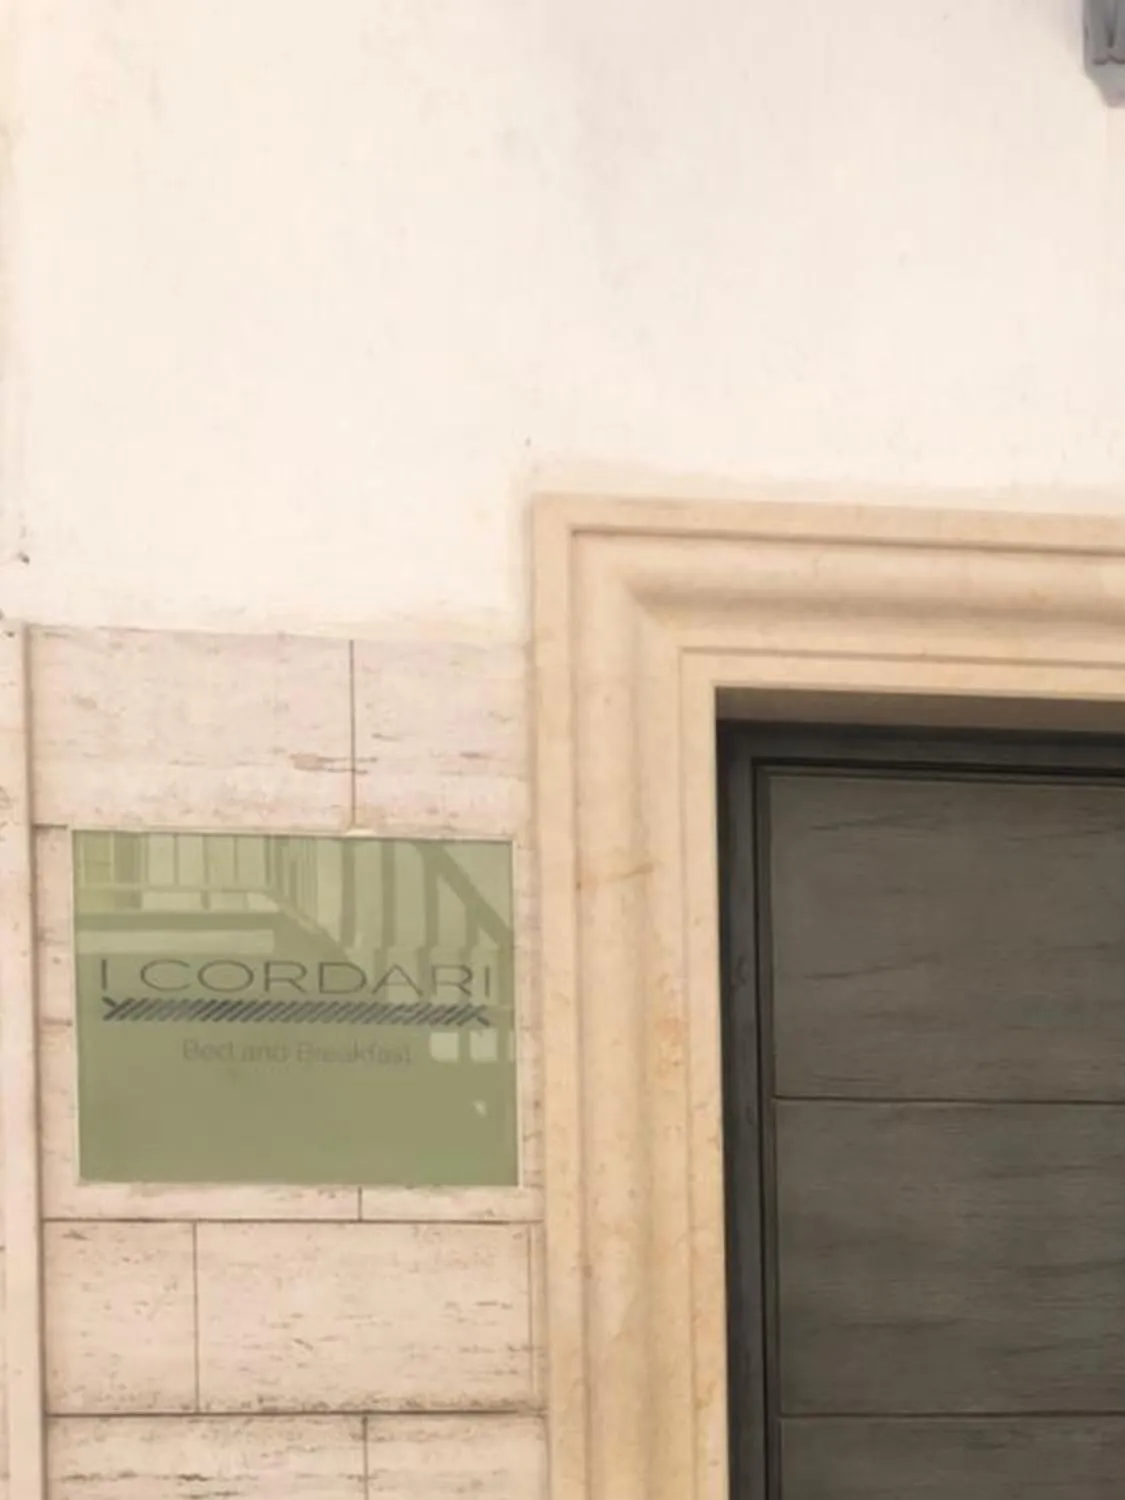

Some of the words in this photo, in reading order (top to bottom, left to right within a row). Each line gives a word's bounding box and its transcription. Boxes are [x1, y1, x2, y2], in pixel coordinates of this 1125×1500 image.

[139, 959, 491, 997] CORDARI
[182, 1037, 233, 1062] Bed
[239, 1039, 289, 1064] and
[296, 1039, 413, 1066] Breakfast
